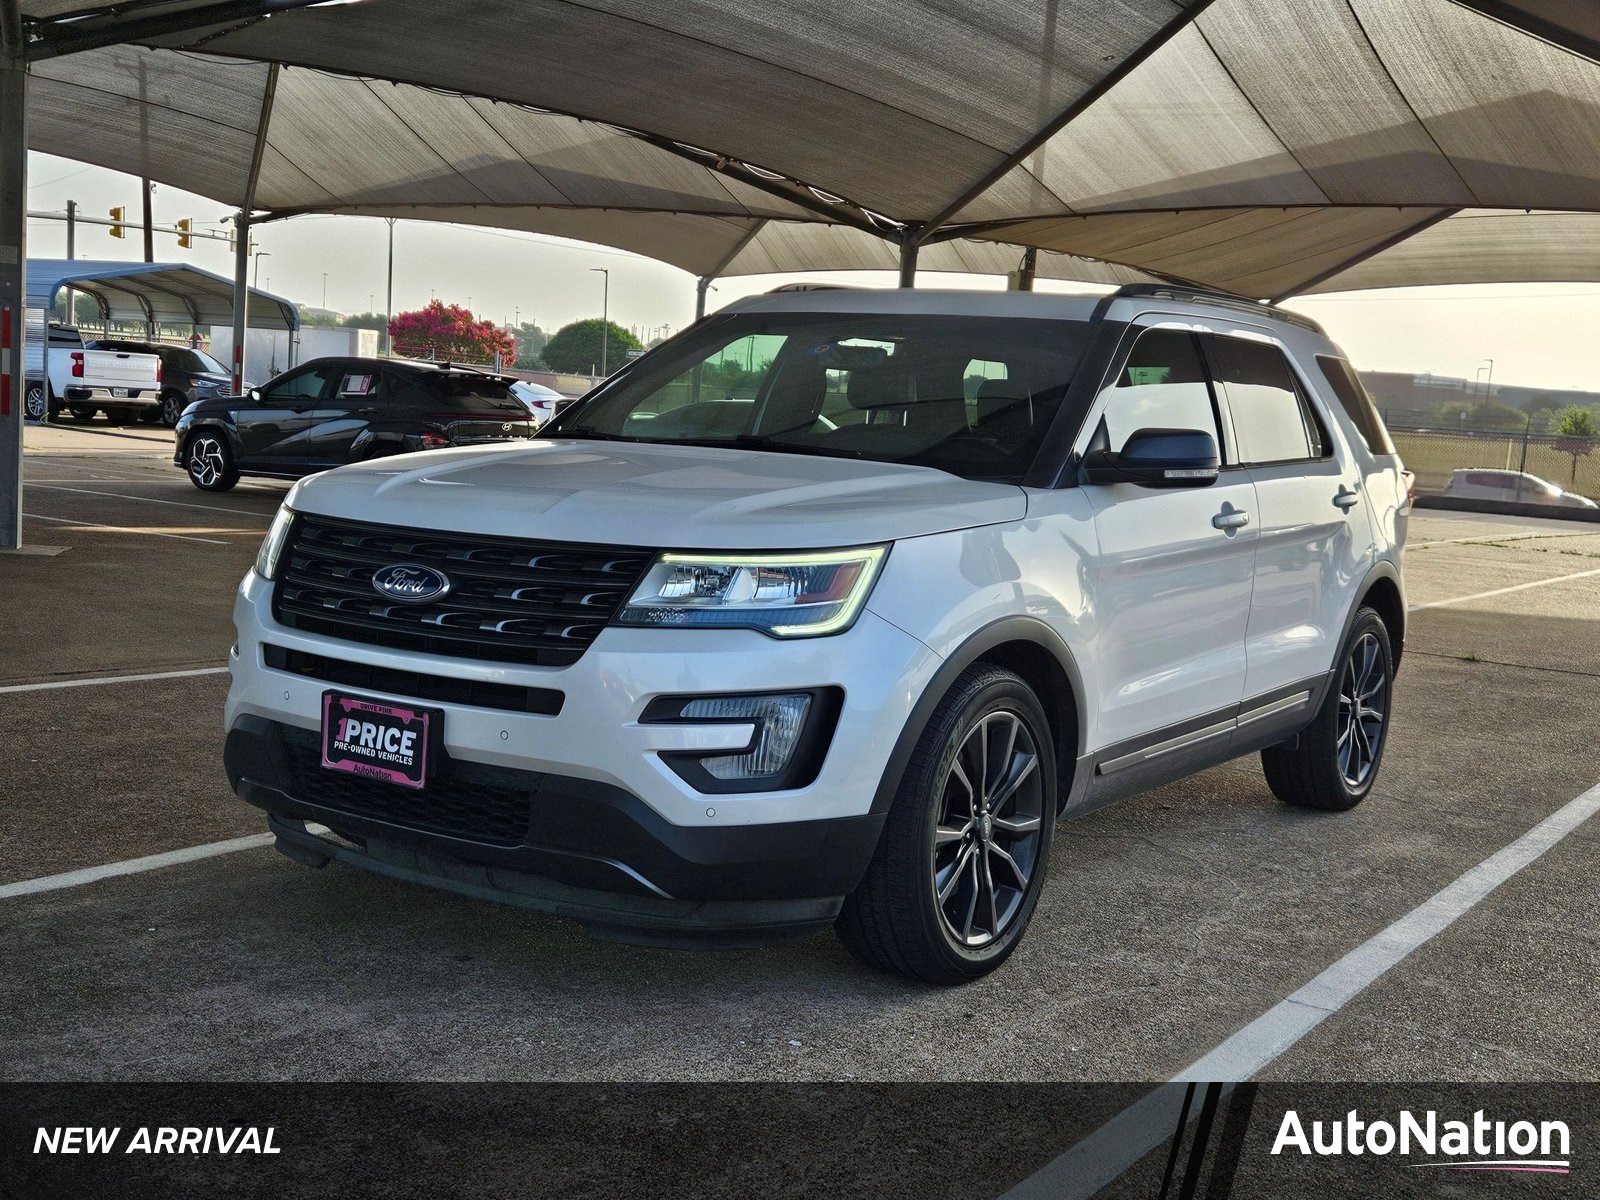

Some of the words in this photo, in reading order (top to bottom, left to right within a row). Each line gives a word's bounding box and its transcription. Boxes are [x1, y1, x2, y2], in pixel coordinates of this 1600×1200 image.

[384, 567, 429, 593] Ford
[360, 702, 378, 713] DRIVE
[379, 706, 393, 715] PINK
[335, 717, 417, 757] 1PRICE
[334, 740, 376, 757] PRE-OWNED
[377, 751, 413, 766] VEHICLES
[353, 764, 392, 780] AutoNation
